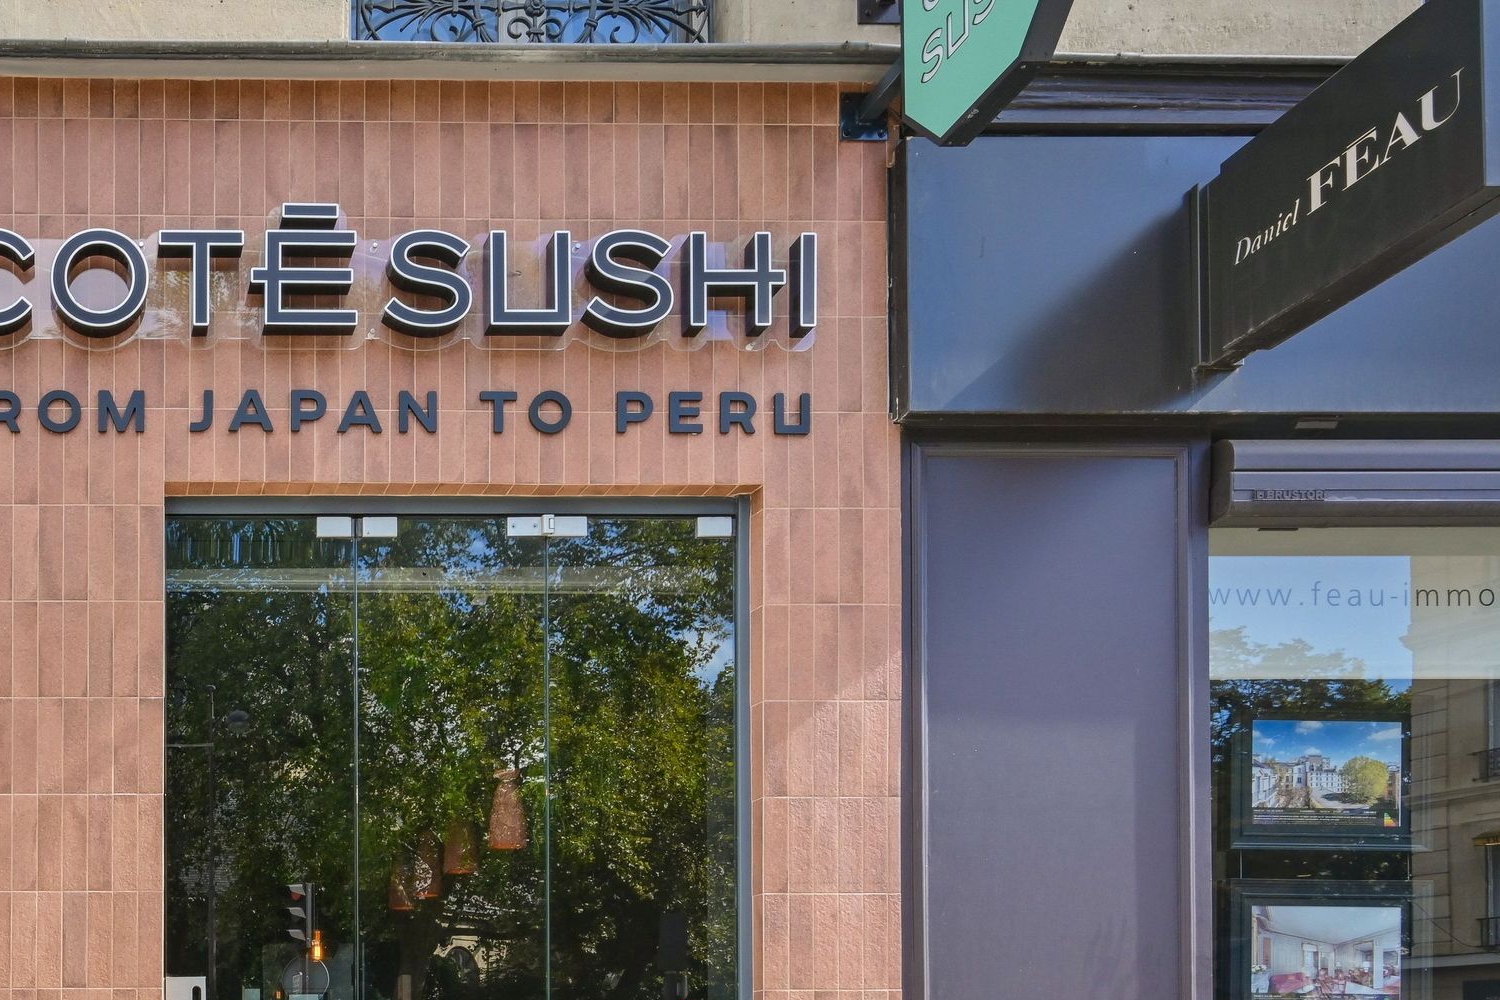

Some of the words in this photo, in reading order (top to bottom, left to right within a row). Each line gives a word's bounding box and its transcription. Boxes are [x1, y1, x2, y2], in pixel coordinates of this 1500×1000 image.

[1234, 198, 1300, 266] Daniel
[189, 389, 438, 434] JAPAN
[479, 390, 573, 435] TO
[615, 391, 811, 436] PERU
[1267, 490, 1325, 500] BRUSTOR
